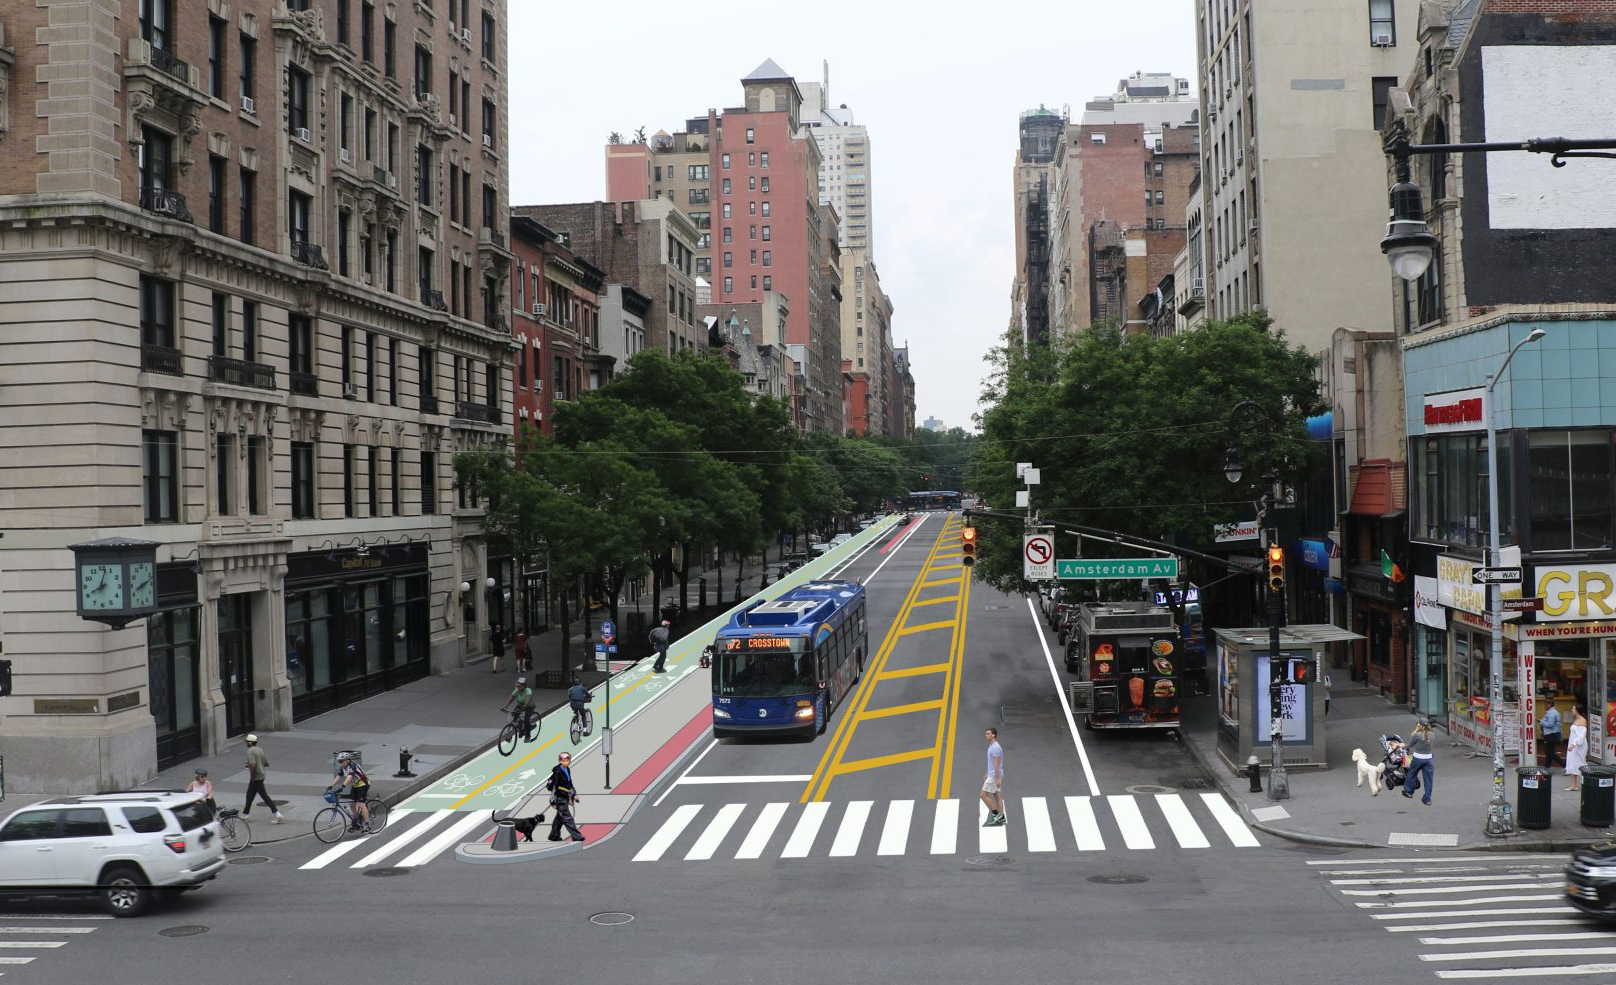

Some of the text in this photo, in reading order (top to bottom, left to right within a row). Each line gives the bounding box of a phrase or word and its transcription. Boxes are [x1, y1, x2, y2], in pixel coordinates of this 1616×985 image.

[1064, 563, 1171, 575] Amsterdam Av
[1537, 571, 1616, 616] GR
[1504, 600, 1534, 608] Amsterdam
[1526, 628, 1555, 637] WHEN
[1557, 626, 1591, 635] YOU'RE
[748, 638, 790, 648] CROSSTOWN
[1524, 655, 1533, 754] WELCOME
